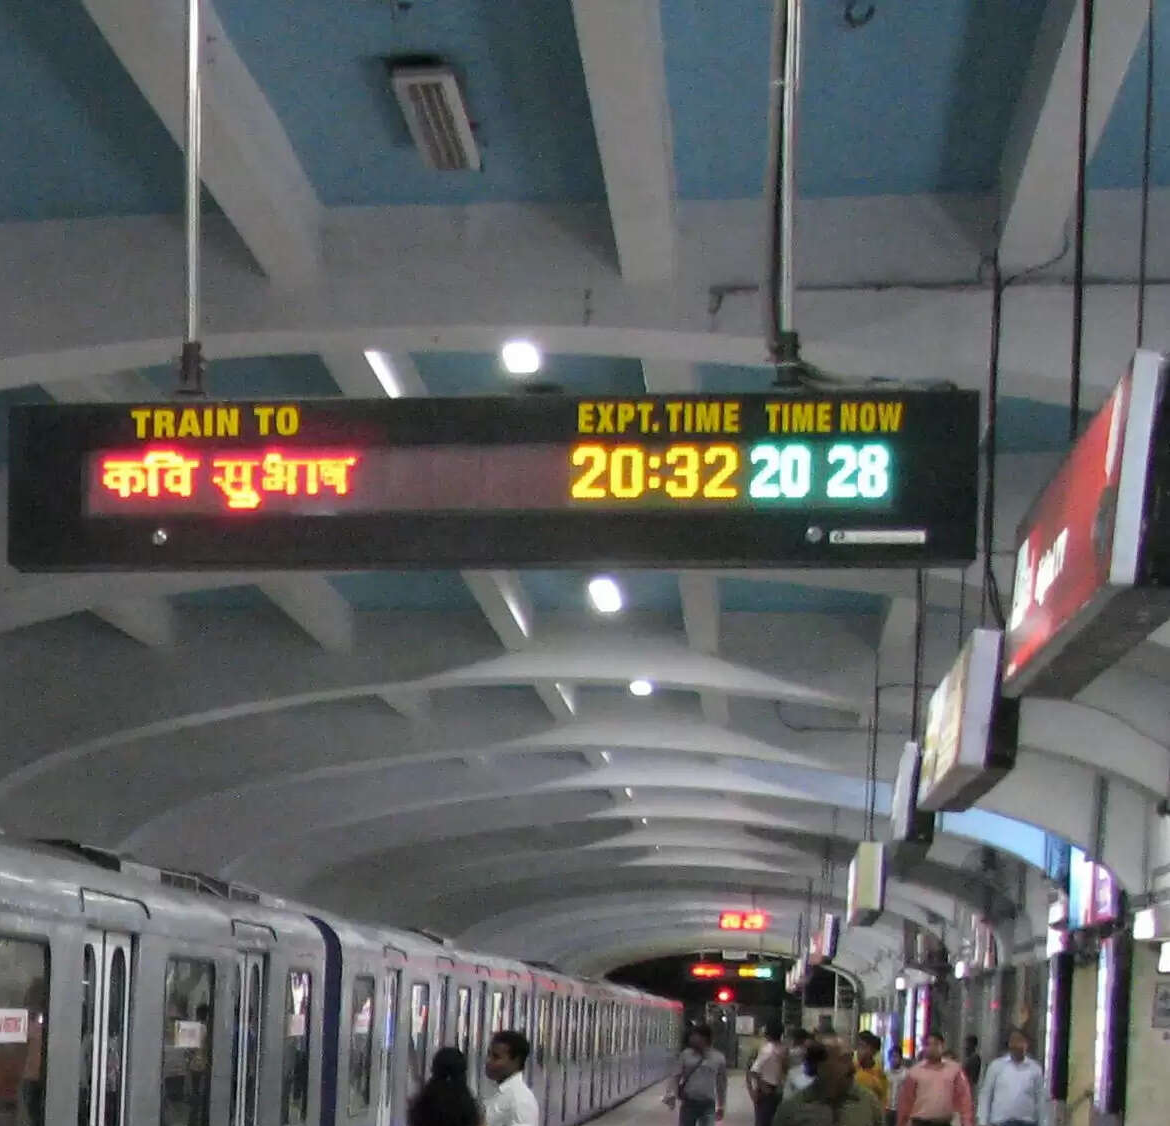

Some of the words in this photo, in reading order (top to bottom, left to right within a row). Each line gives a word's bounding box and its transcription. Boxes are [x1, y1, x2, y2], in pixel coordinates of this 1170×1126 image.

[131, 407, 241, 438] TRAIN
[254, 406, 300, 436] TO
[578, 402, 660, 433] EXPT.
[666, 402, 741, 433] TIME
[765, 402, 832, 433] TIME
[840, 402, 903, 433] NOW
[103, 451, 200, 497] कवि
[212, 452, 356, 509] सुभाष
[572, 445, 738, 498] 20:32
[749, 444, 812, 499] 20
[826, 444, 890, 499] 28
